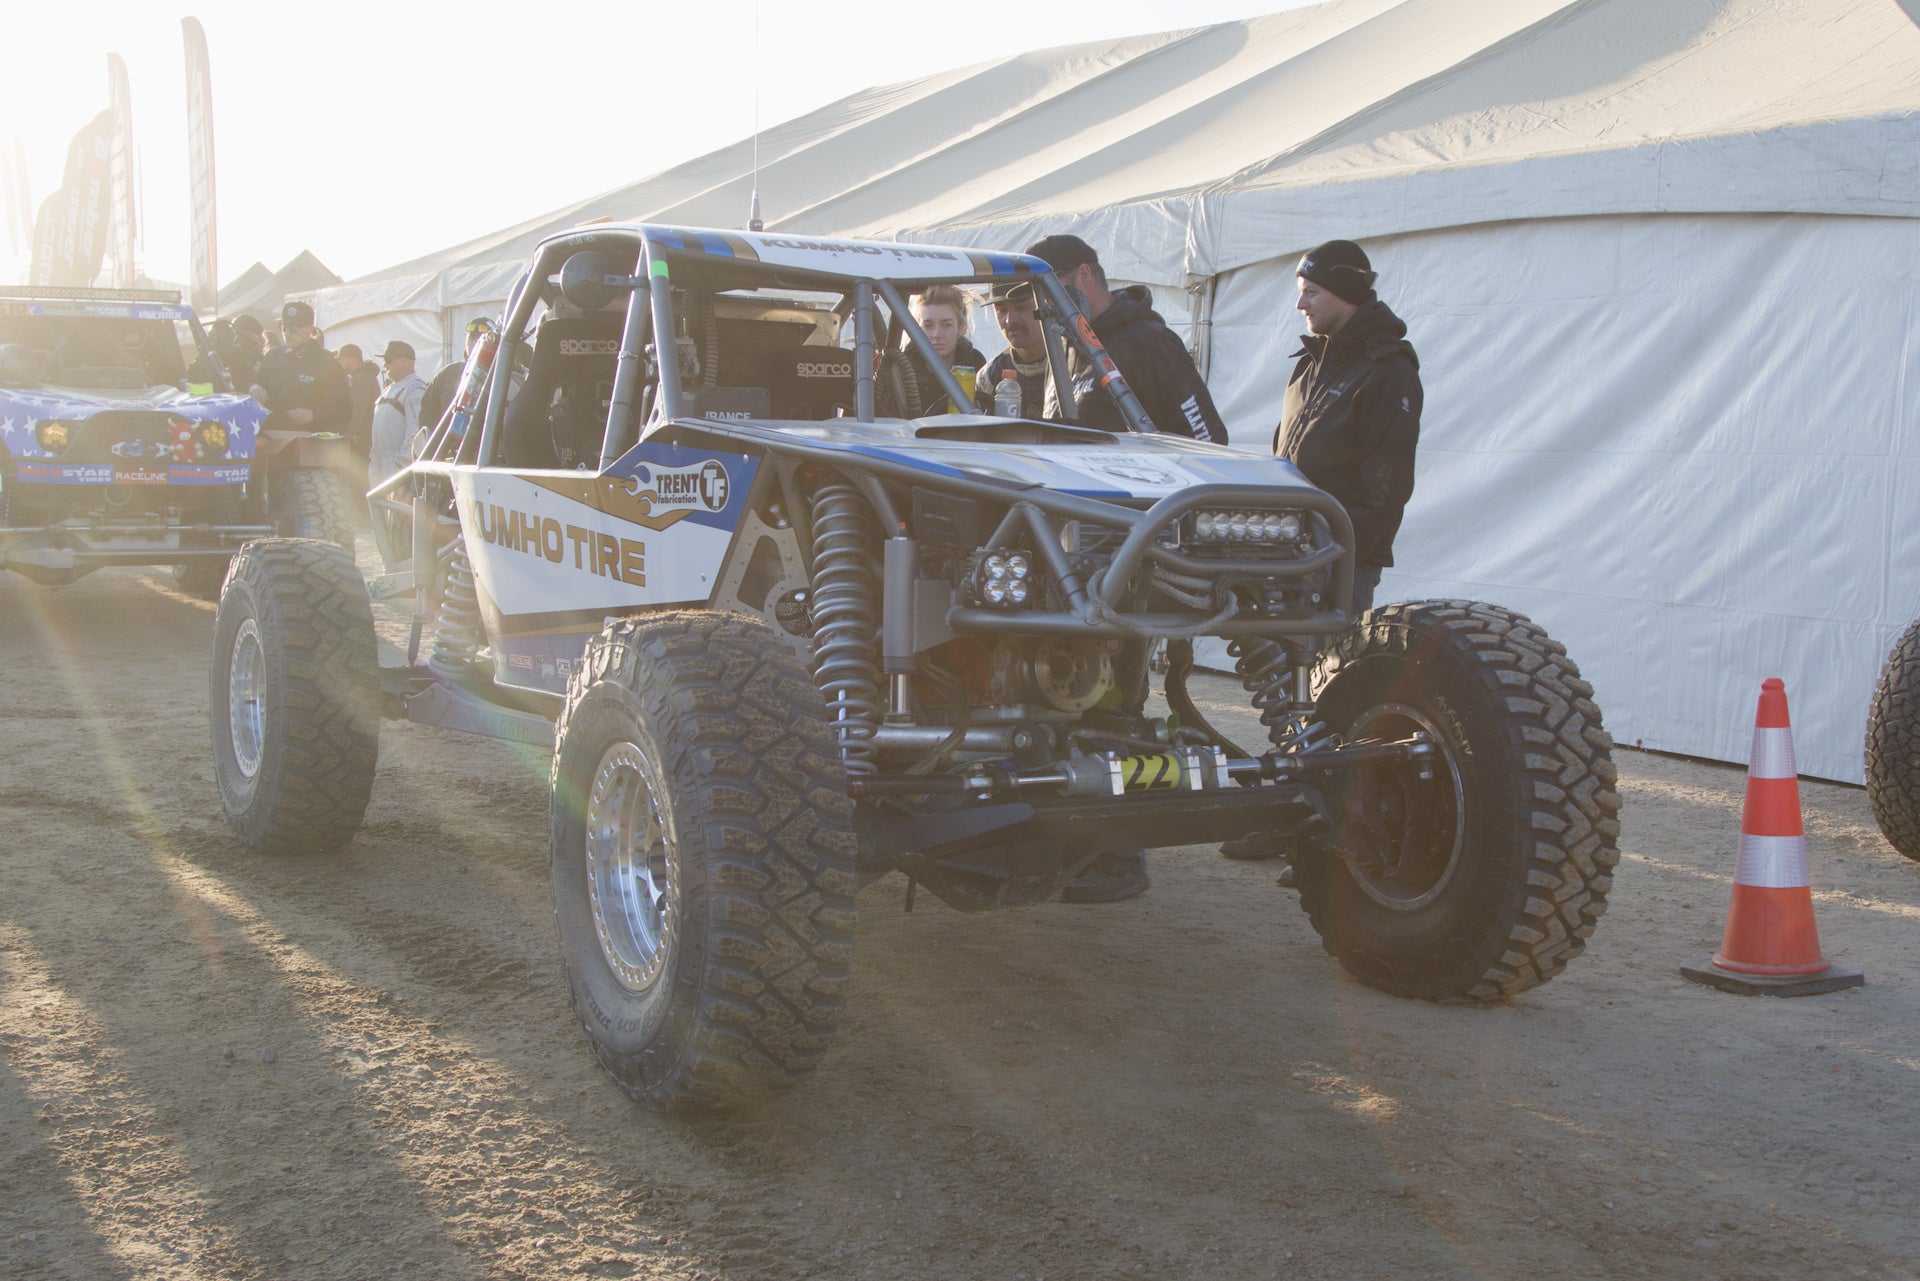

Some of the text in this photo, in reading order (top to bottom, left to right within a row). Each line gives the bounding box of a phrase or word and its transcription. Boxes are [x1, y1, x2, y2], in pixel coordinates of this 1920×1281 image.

[759, 238, 957, 260] KUMHO TIRE
[559, 339, 618, 356] sparco
[796, 362, 851, 378] sparco
[115, 472, 167, 481] RACELINE
[656, 473, 700, 493] TRENT
[656, 494, 697, 504] fabrication
[466, 498, 647, 588] KUMHO TIRE
[1120, 753, 1172, 790] 22
